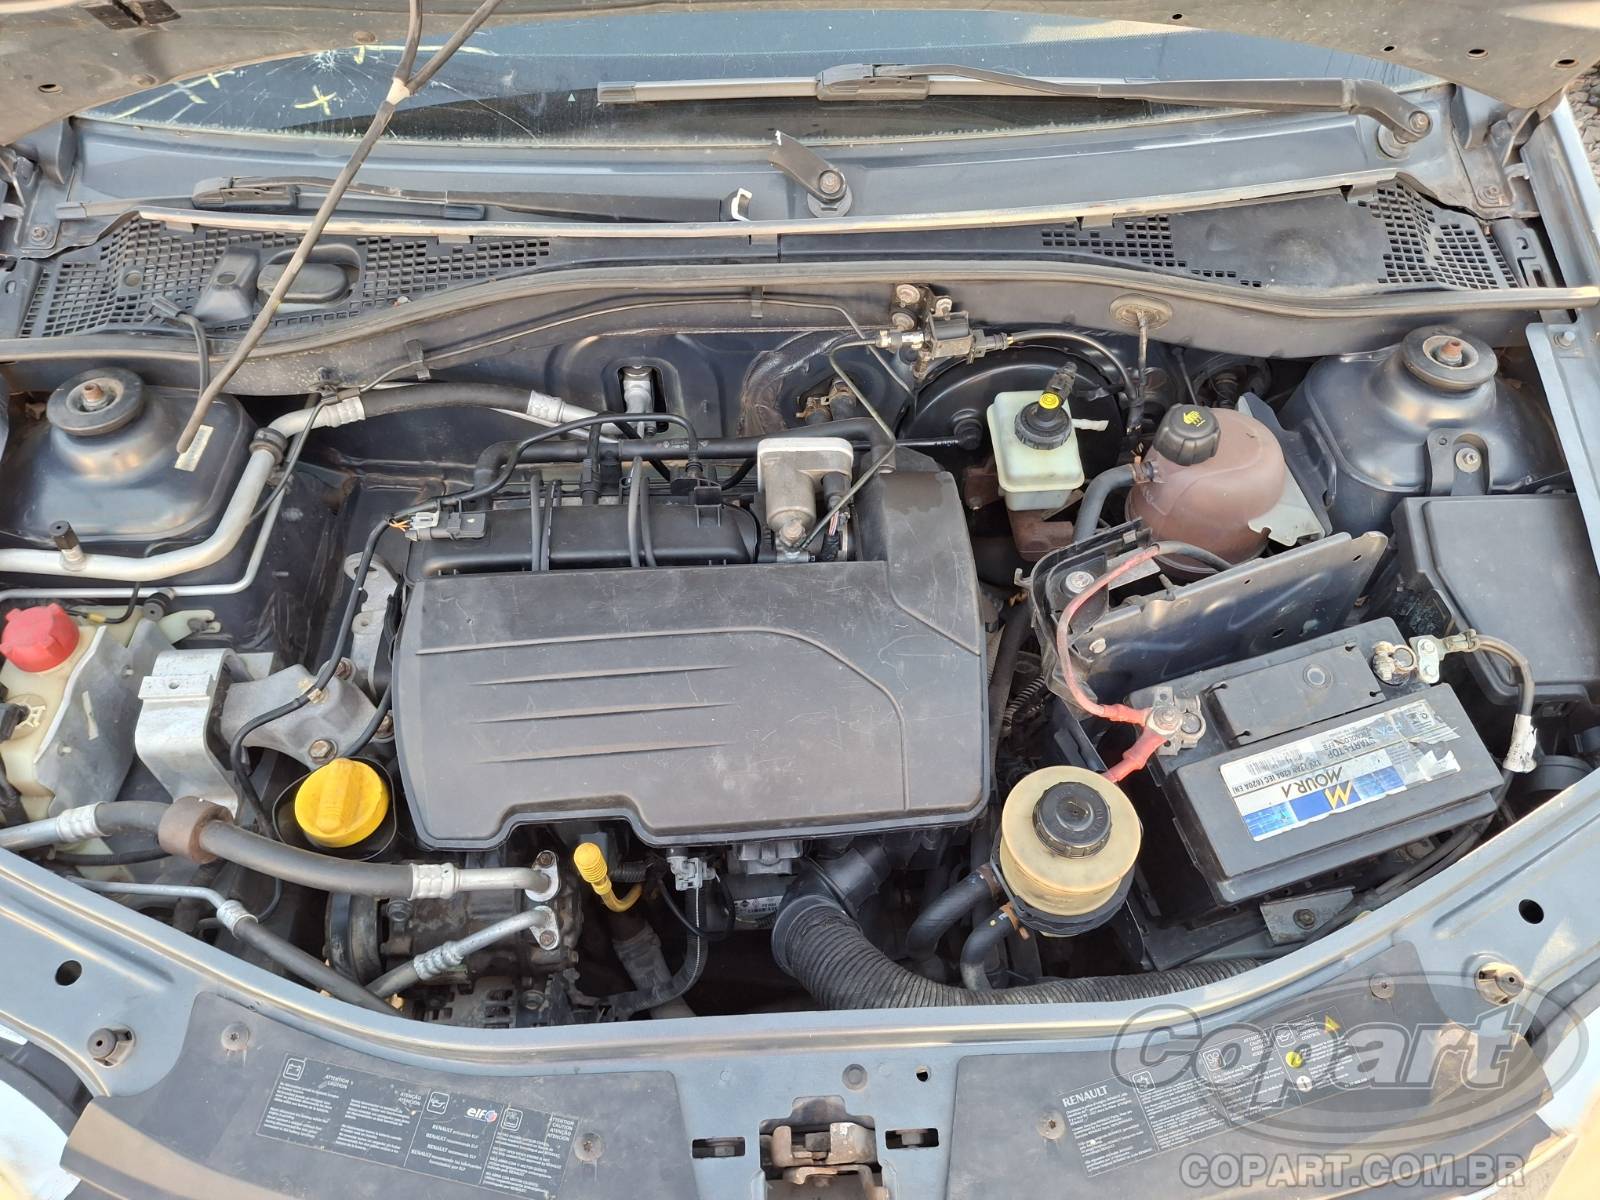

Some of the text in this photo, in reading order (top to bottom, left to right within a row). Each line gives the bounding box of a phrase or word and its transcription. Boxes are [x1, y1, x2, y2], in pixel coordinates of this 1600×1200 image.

[1280, 766, 1344, 798] MOURA
[1062, 1085, 1108, 1108] RENAULT
[466, 1107, 488, 1118] elf
